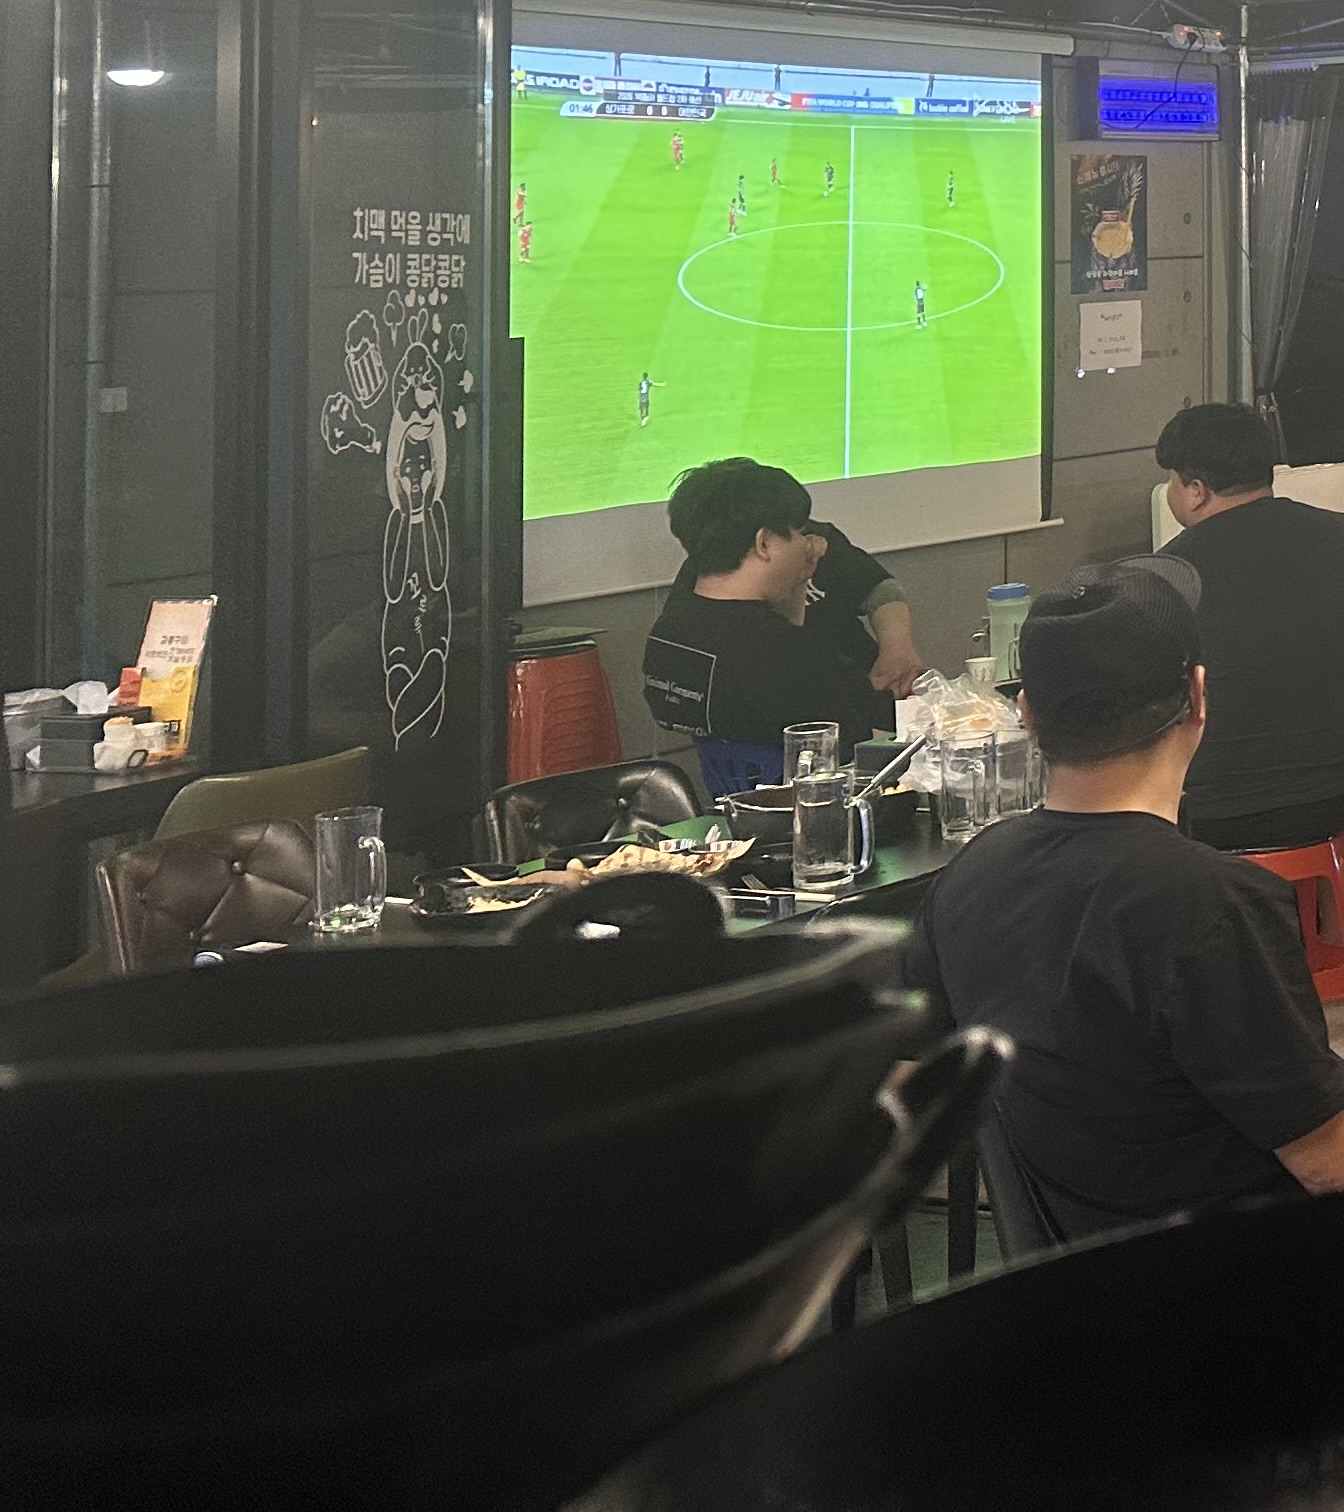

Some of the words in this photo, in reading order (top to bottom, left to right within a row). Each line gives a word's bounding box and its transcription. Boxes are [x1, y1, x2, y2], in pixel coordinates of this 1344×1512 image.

[568, 103, 594, 114] 01:46
[352, 206, 386, 245] 치맥
[391, 210, 422, 246] 먹을
[426, 212, 471, 247] 생각에
[352, 251, 400, 288] 가슴이
[405, 253, 467, 288] 콩닭콩닭
